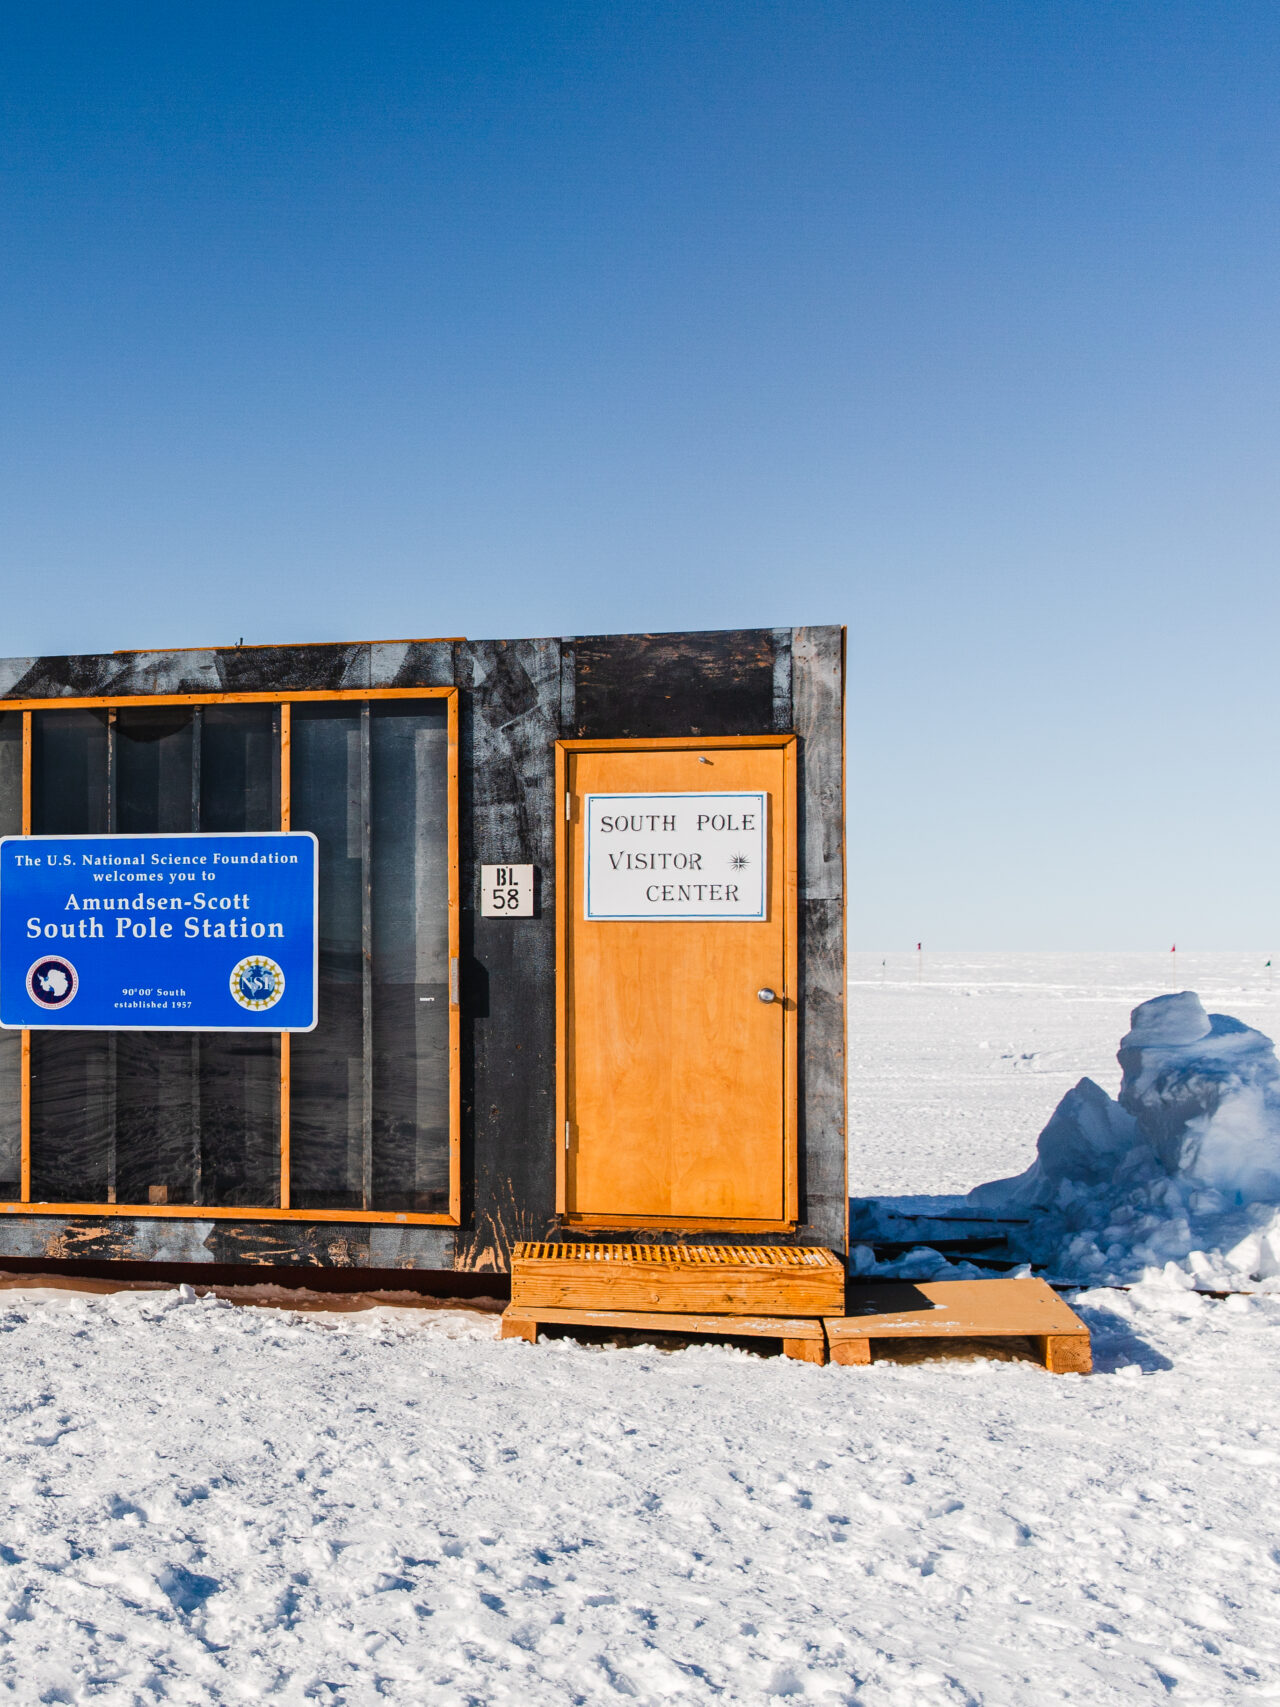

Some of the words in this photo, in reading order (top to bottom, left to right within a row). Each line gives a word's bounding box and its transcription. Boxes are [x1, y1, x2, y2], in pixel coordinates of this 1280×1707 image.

[600, 815, 676, 832] SOUTH
[696, 814, 756, 831] POLE
[14, 855, 41, 867] The
[47, 854, 77, 866] U.S.
[82, 853, 145, 866] National
[151, 853, 207, 865] Science
[213, 852, 299, 865] Foundation
[608, 850, 702, 870] VISITOR
[93, 870, 164, 882] welcomes
[169, 872, 196, 885] you
[201, 870, 216, 881] to
[496, 867, 519, 886] BL
[64, 892, 250, 911] Amundsen-Scott
[492, 888, 519, 910] 58
[645, 884, 739, 902] CENTER
[26, 916, 105, 938] South
[115, 916, 173, 938] Pole
[184, 916, 285, 938] Station
[156, 988, 186, 997] South
[114, 1001, 168, 1009] established
[172, 1001, 192, 1009] 1957
